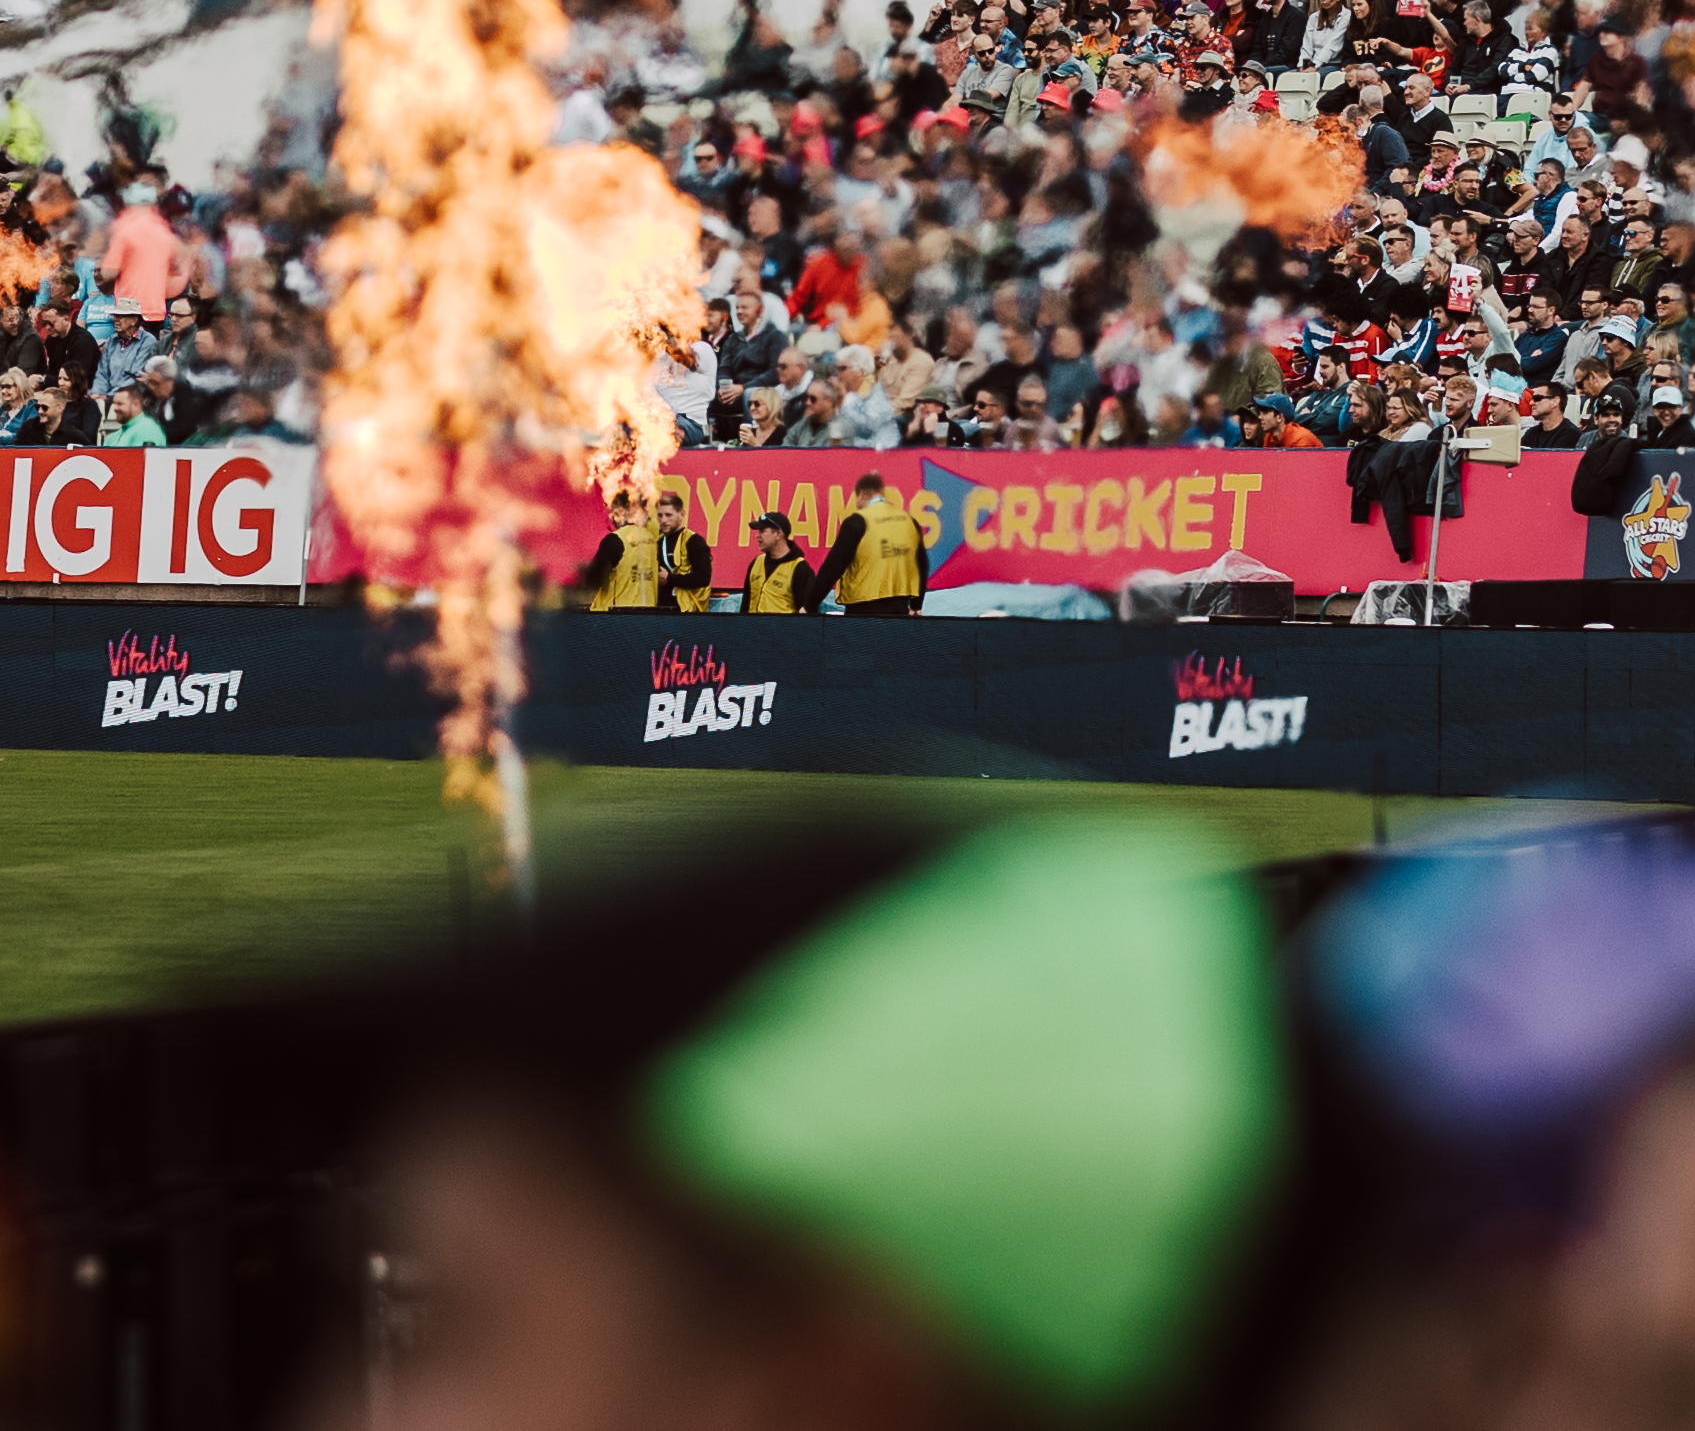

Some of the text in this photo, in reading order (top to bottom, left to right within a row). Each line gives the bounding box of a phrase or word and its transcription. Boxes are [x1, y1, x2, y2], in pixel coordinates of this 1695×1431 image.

[5, 455, 114, 576] IG
[170, 456, 277, 578] IG
[962, 473, 1263, 555] CRICKET
[1624, 516, 1689, 543] ALL STARS
[108, 629, 189, 679] Vitality
[651, 640, 726, 695] Vitality
[101, 670, 243, 728] BLAST!
[643, 682, 777, 742] BLAST!
[1169, 696, 1308, 759] BLAST!
